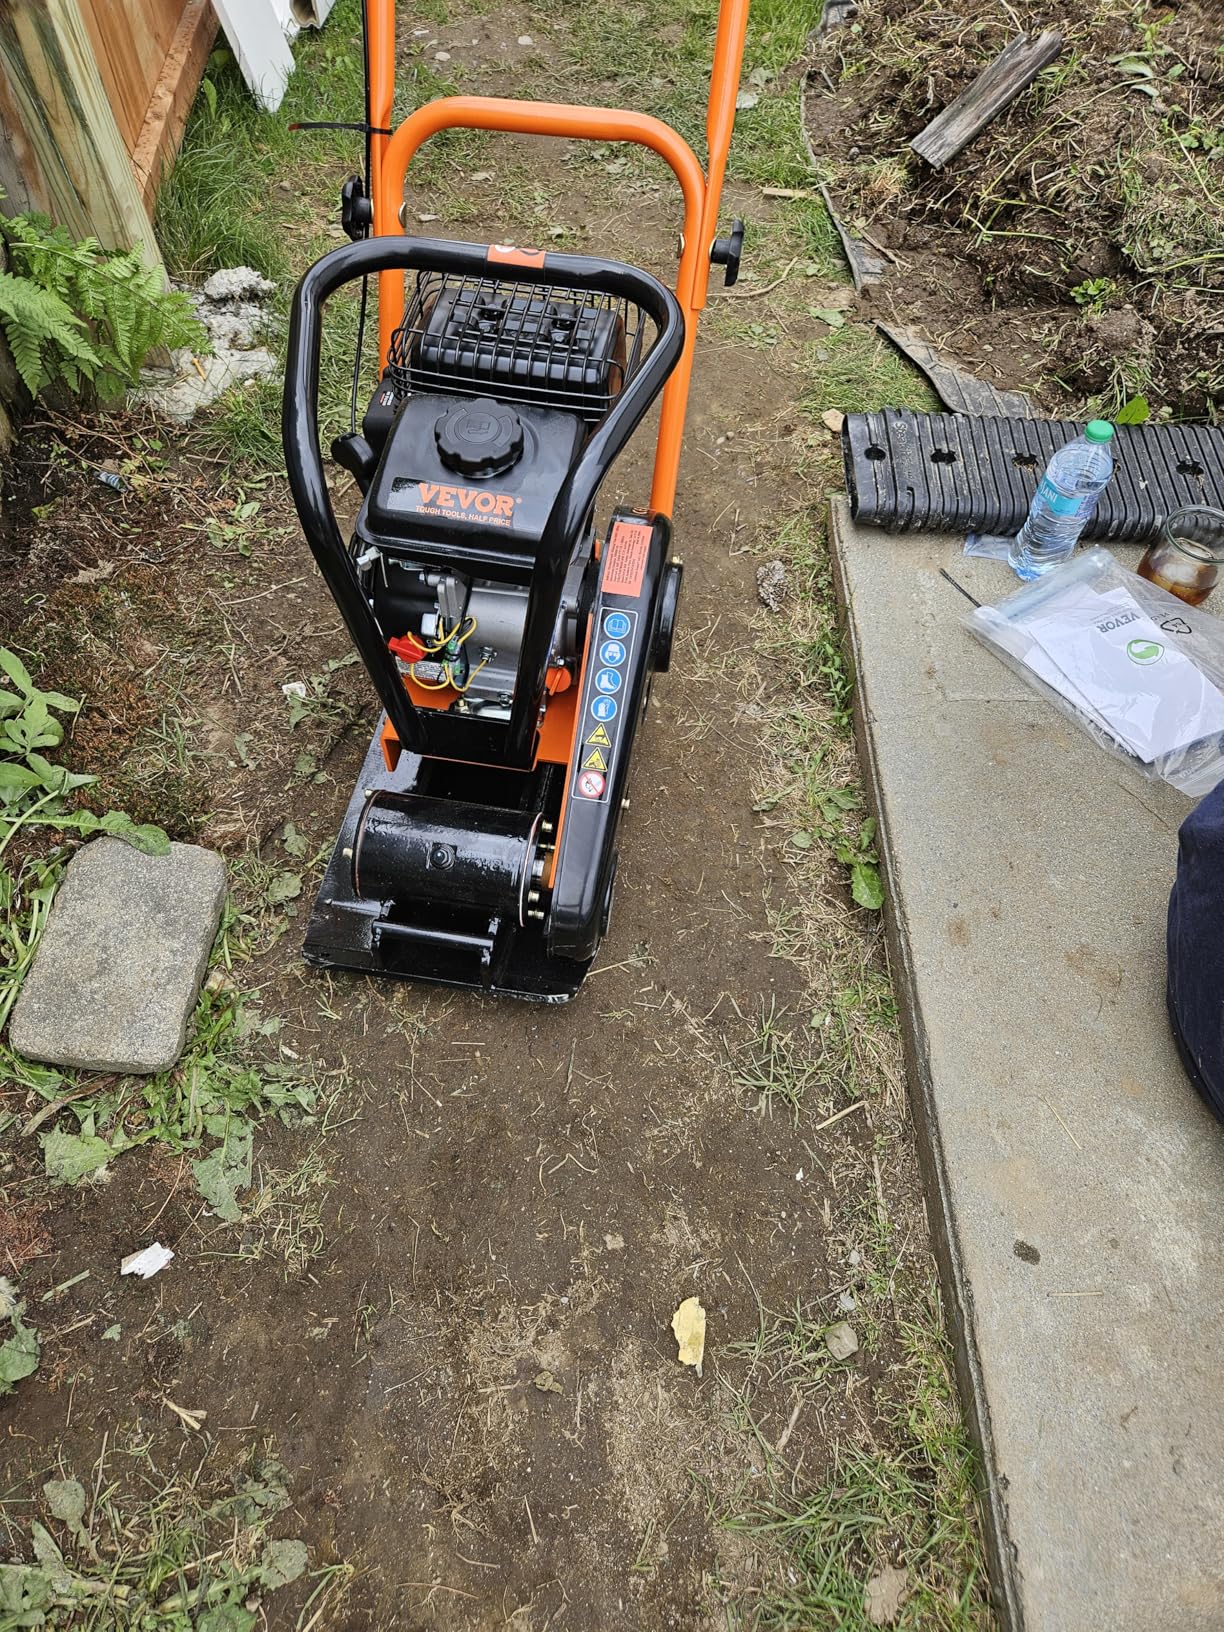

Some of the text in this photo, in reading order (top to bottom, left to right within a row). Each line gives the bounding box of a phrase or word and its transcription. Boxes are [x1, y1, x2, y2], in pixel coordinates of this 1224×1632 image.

[418, 482, 514, 517] VEVOR
[415, 505, 511, 526] TOUGH TOOLS, HALF PRICE
[1096, 612, 1140, 633] VEVOR
